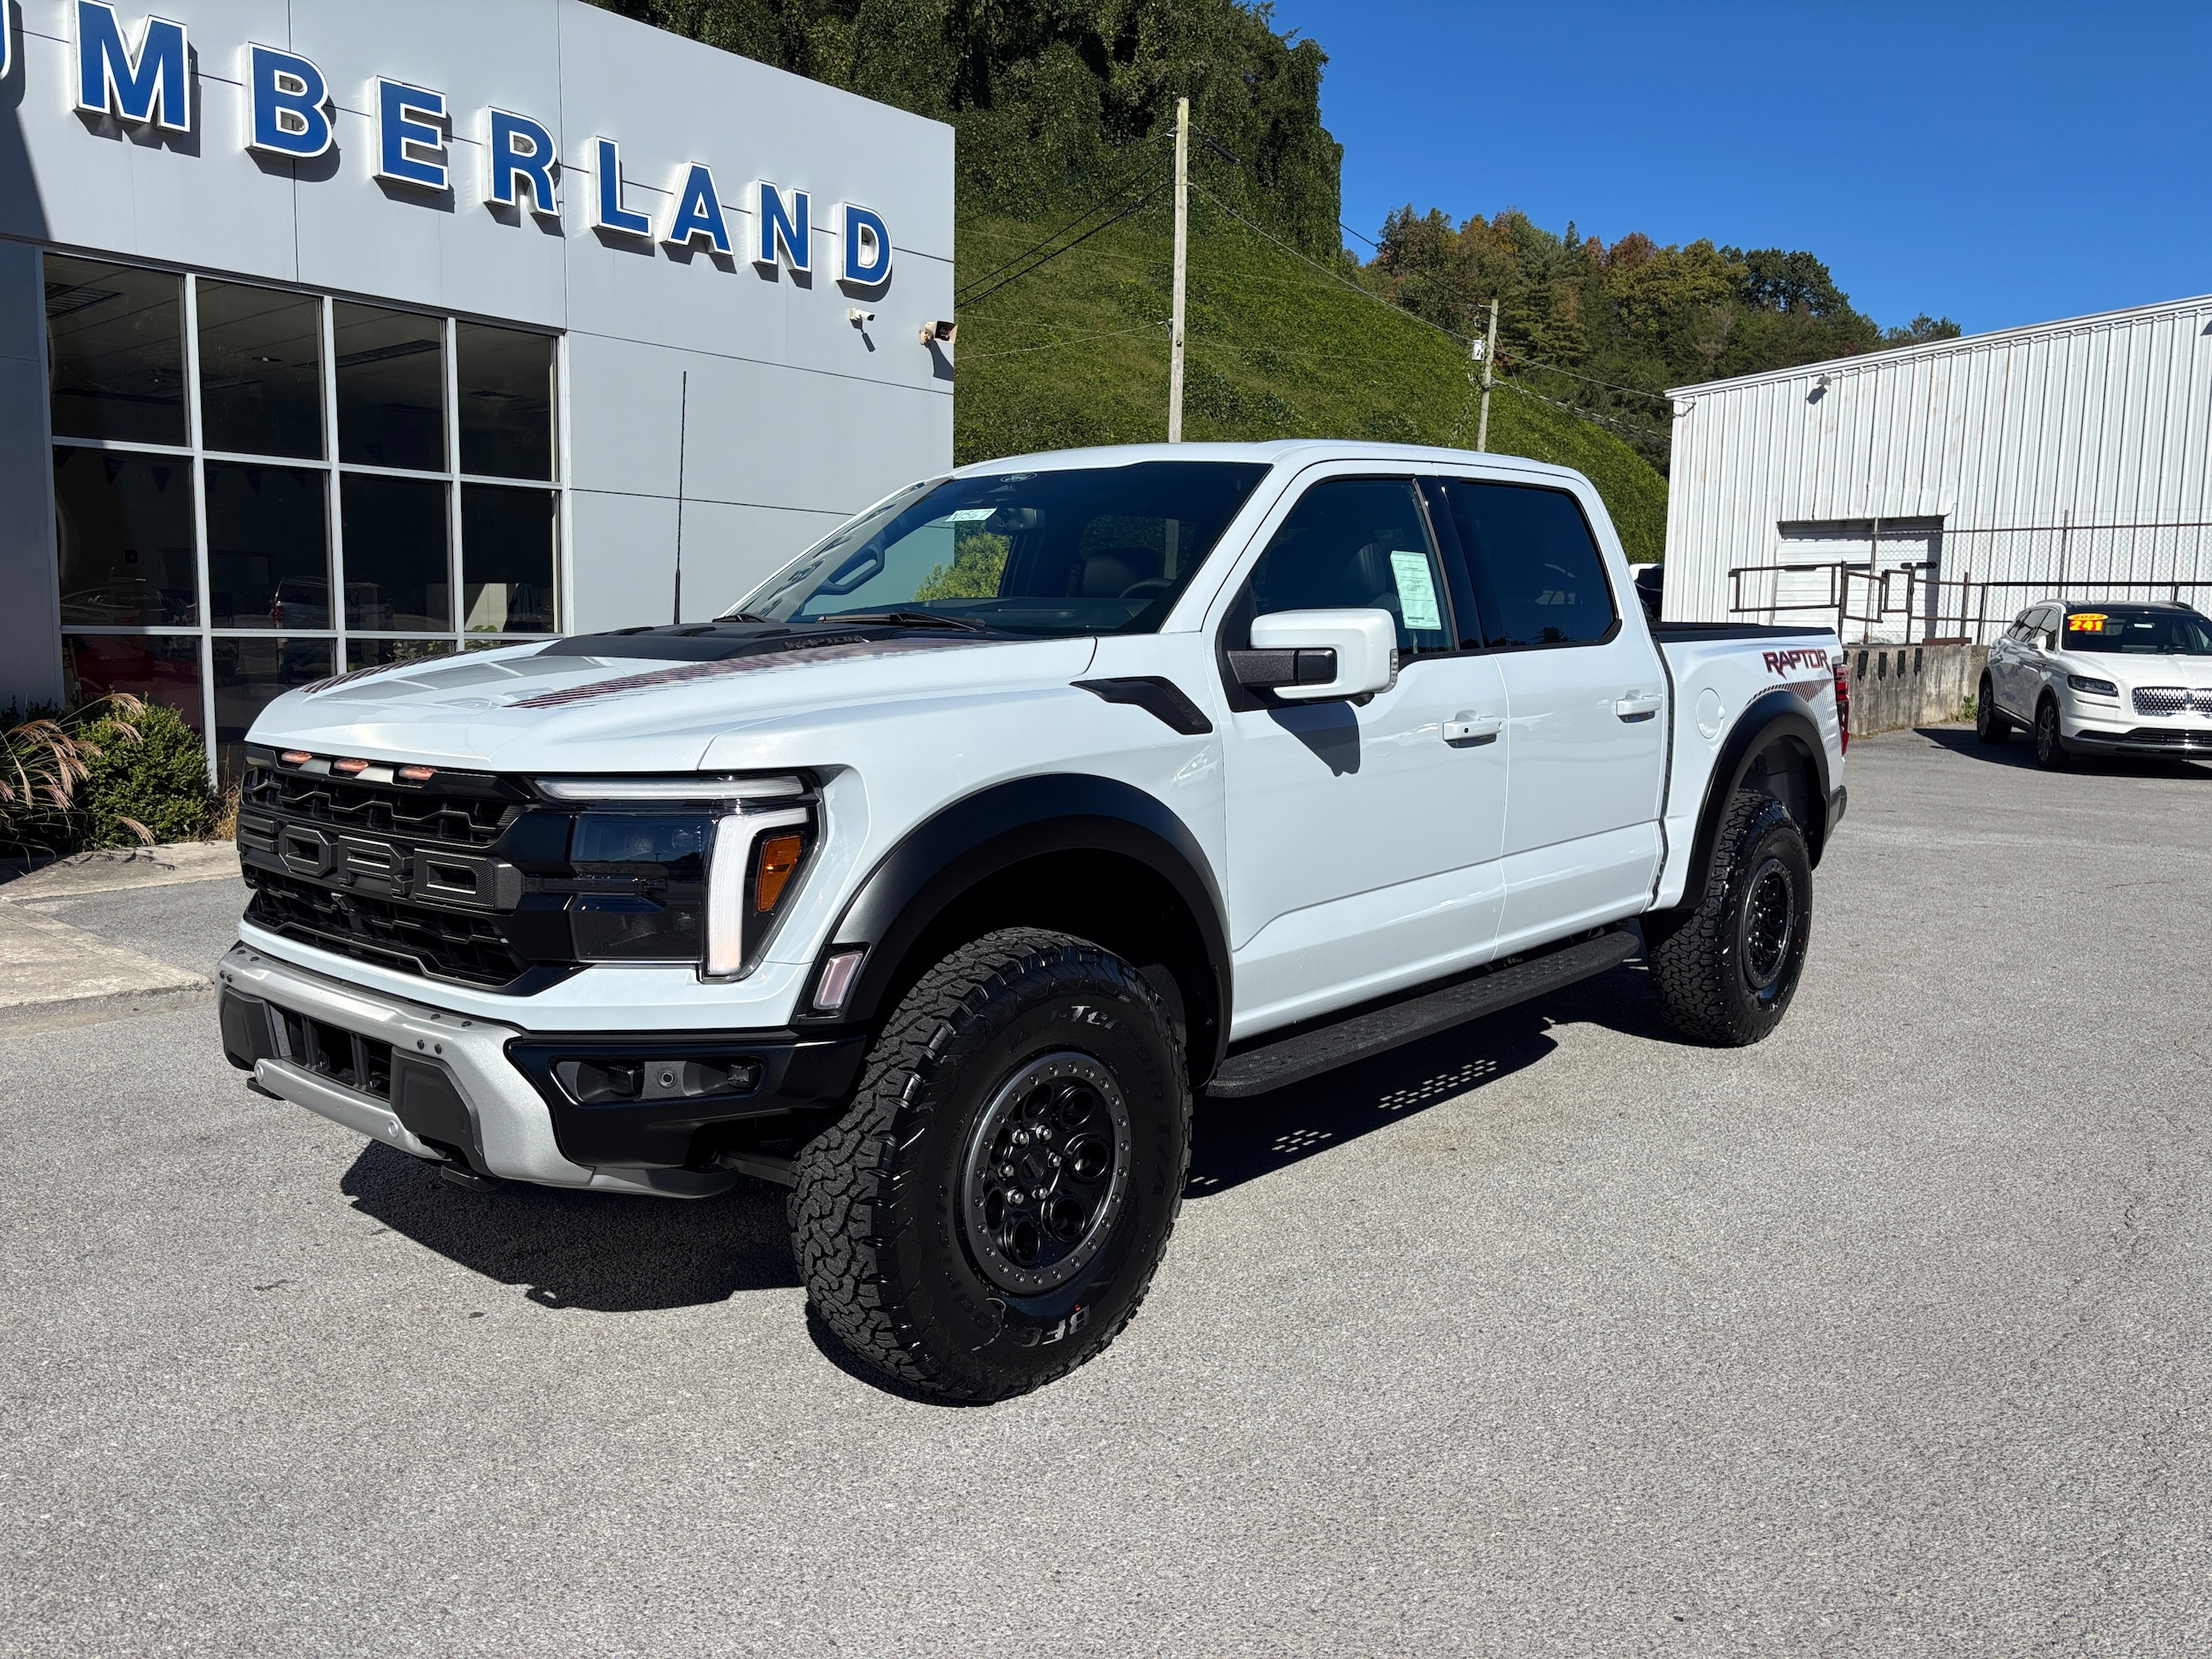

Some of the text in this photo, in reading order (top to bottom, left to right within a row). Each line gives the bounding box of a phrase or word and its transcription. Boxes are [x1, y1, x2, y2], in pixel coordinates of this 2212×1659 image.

[0, 0, 893, 287] MBERLAND
[2070, 621, 2103, 632] 241
[1762, 649, 1832, 680] RAPTOR
[239, 811, 519, 913] FORD
